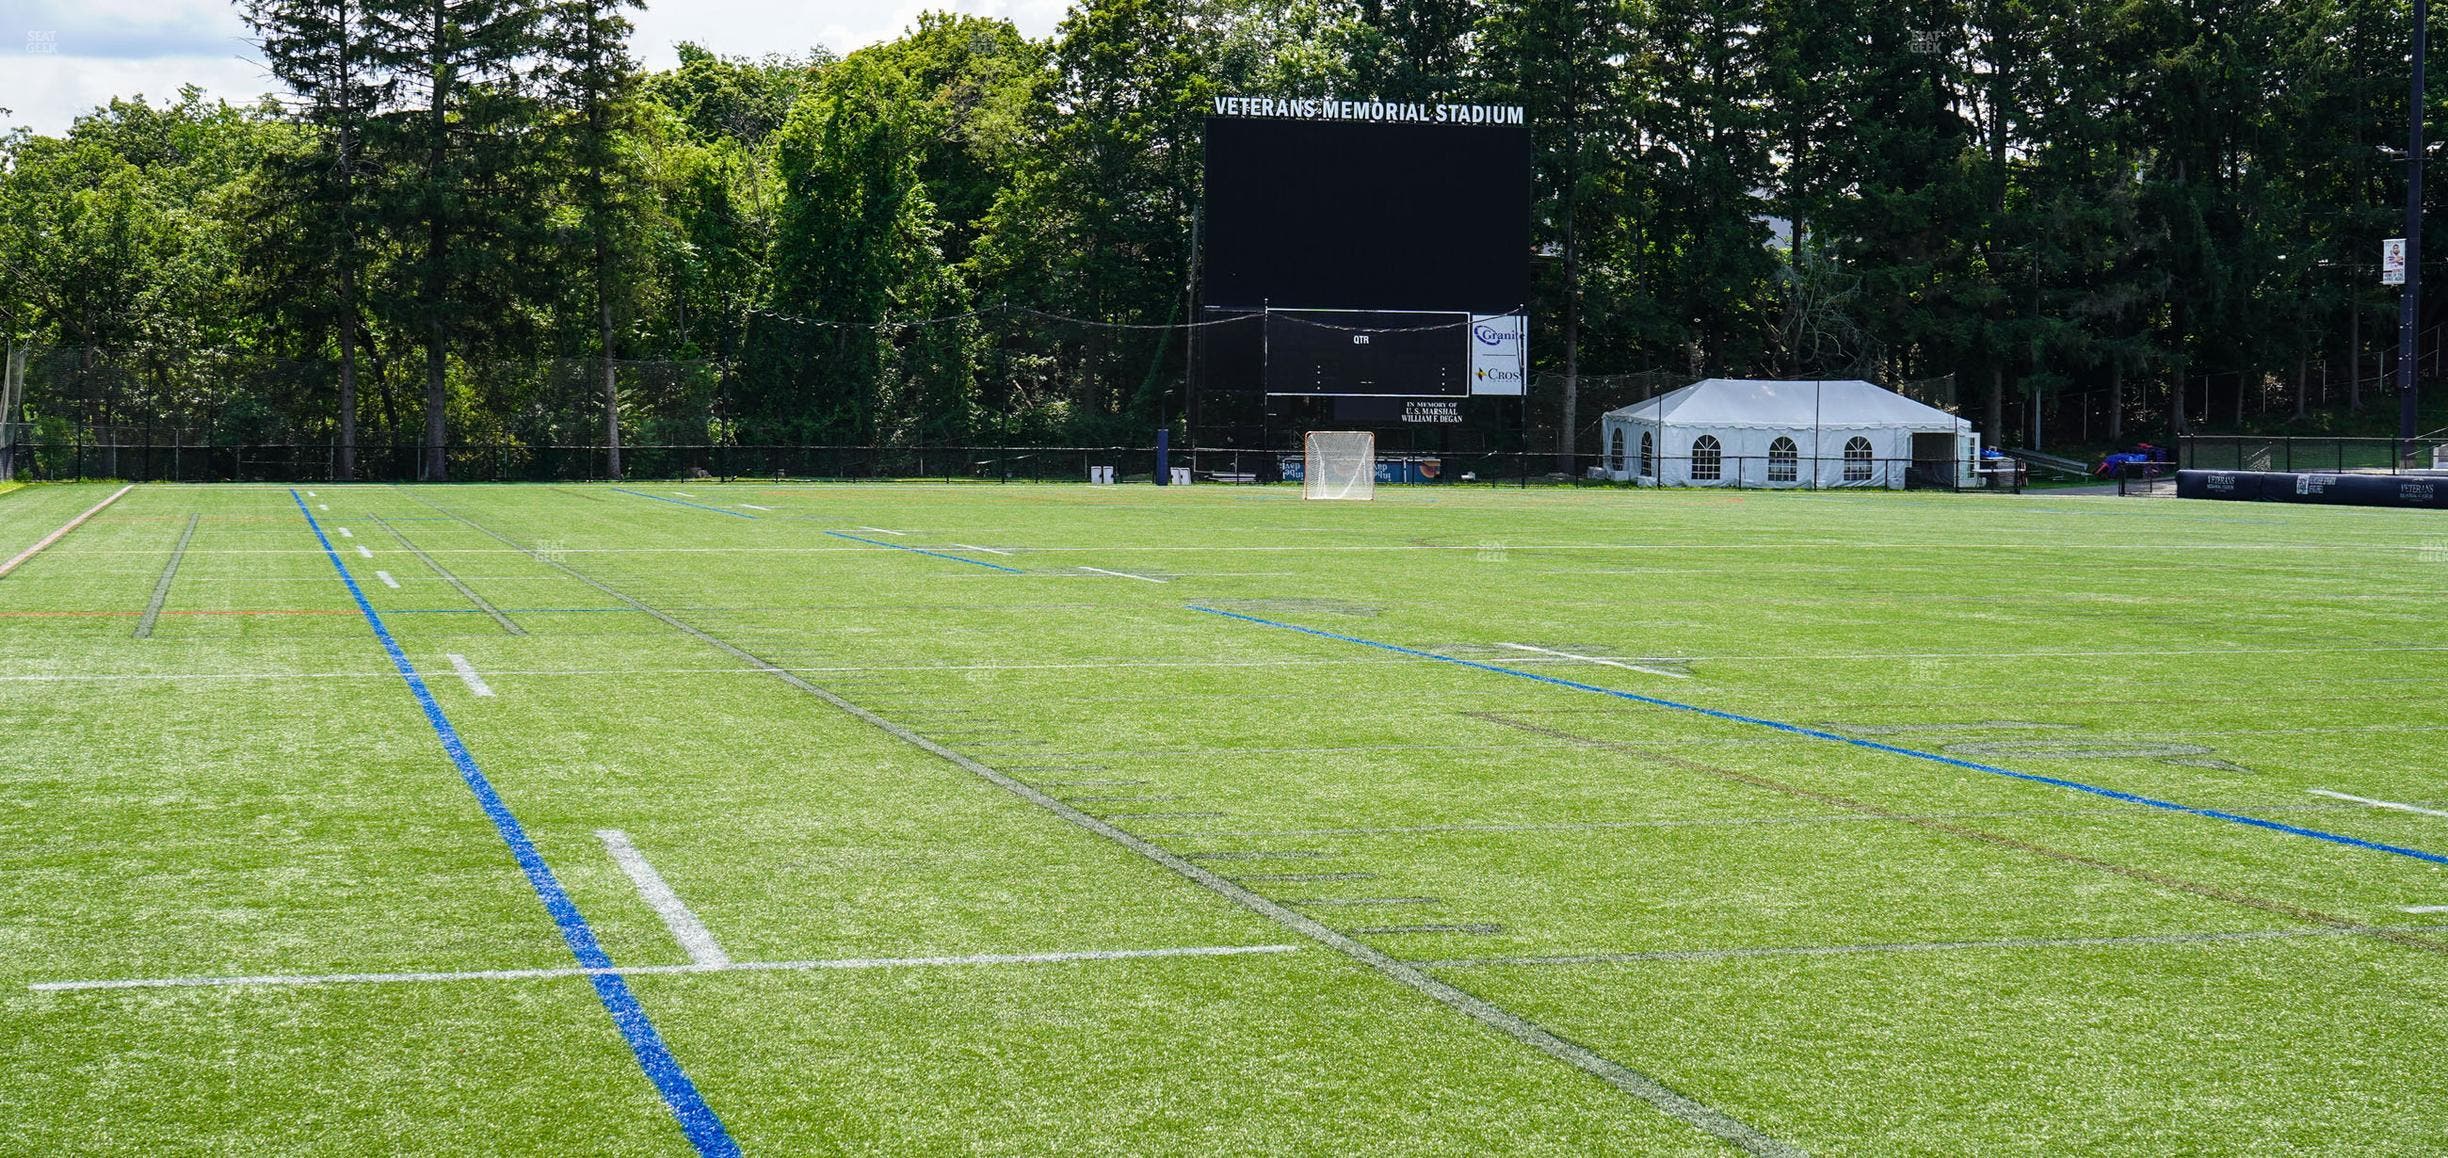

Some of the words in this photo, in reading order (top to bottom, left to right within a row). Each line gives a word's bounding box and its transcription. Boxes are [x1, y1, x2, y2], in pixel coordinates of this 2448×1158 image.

[1214, 96, 1316, 118] VETERANS
[1322, 101, 1429, 122] MEMORIAL
[1435, 103, 1524, 125] STADIUM
[1353, 335, 1369, 344] QTR
[1482, 329, 1525, 340] Grani
[1488, 368, 1523, 380] CROS
[1401, 414, 1432, 423] WILLIAM
[1439, 415, 1463, 423] DEGAN
[2401, 483, 2434, 493] VETERANS
